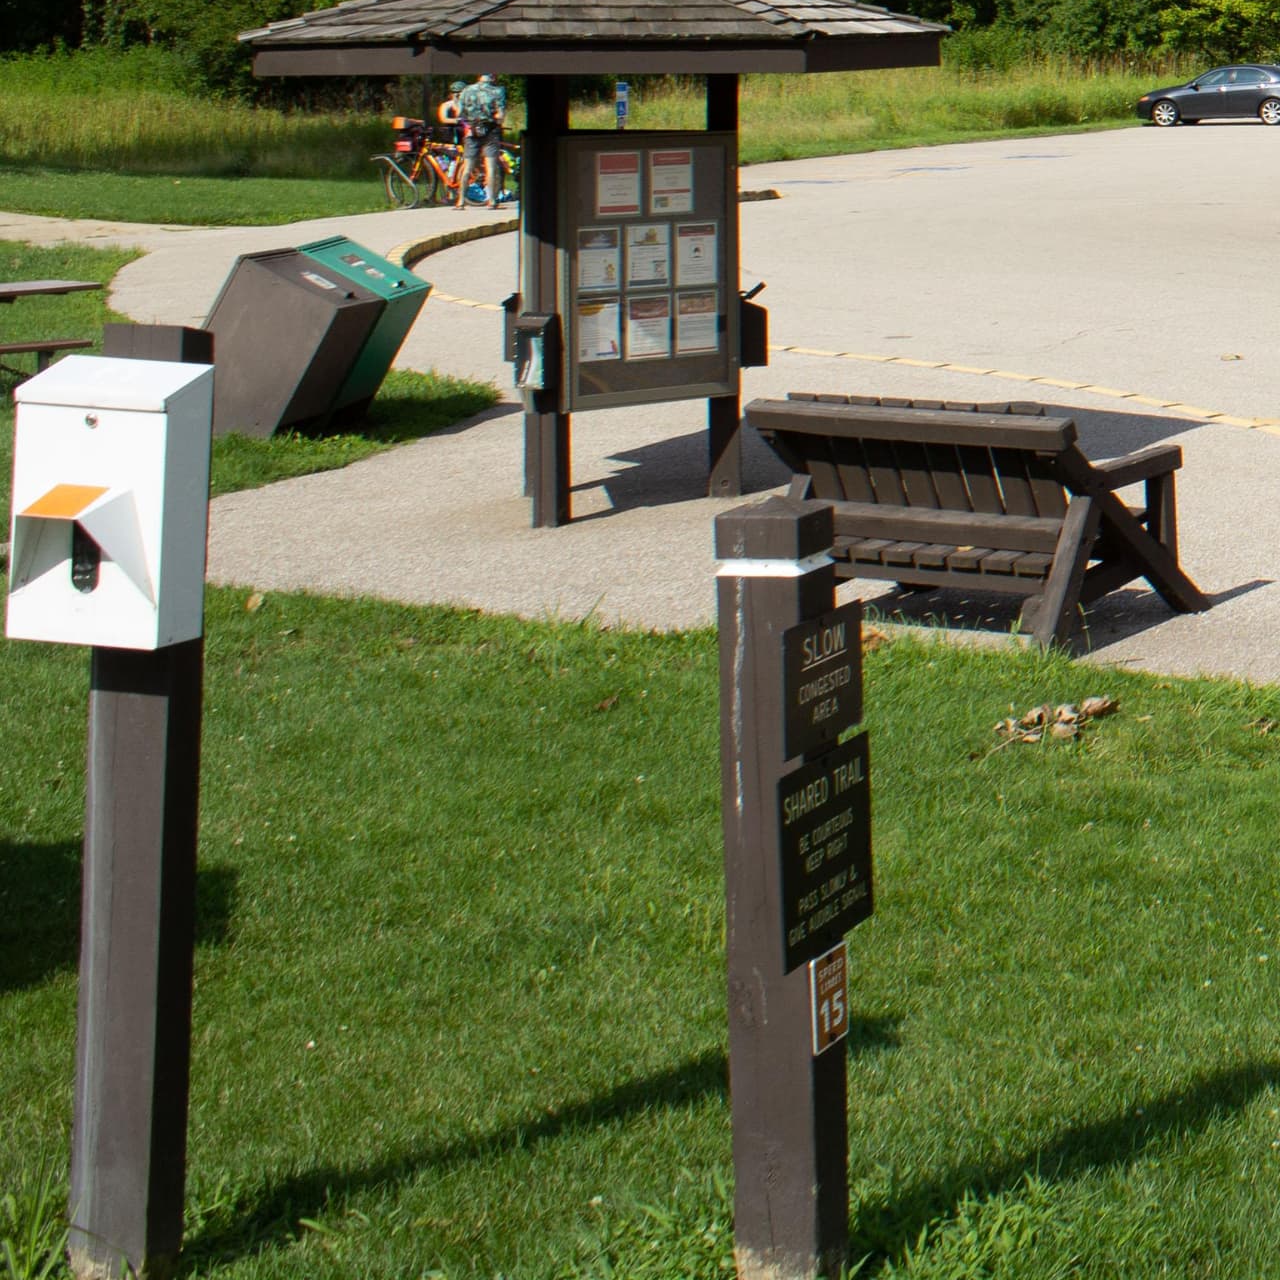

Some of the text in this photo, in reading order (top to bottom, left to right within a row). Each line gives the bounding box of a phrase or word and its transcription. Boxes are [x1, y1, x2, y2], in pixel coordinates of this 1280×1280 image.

[803, 622, 846, 665] SLOW
[799, 664, 851, 705] CONGESTED
[812, 696, 839, 724] AREA
[784, 756, 865, 825] SHARED TRAIL
[799, 807, 854, 856] BE COURTEOUS
[806, 832, 848, 873] KEEP RIGHT
[799, 889, 819, 916] PASS
[821, 869, 848, 901] SLOWLY
[818, 957, 844, 983] SPEED
[821, 971, 842, 995] LIMIT
[819, 989, 845, 1034] 15
